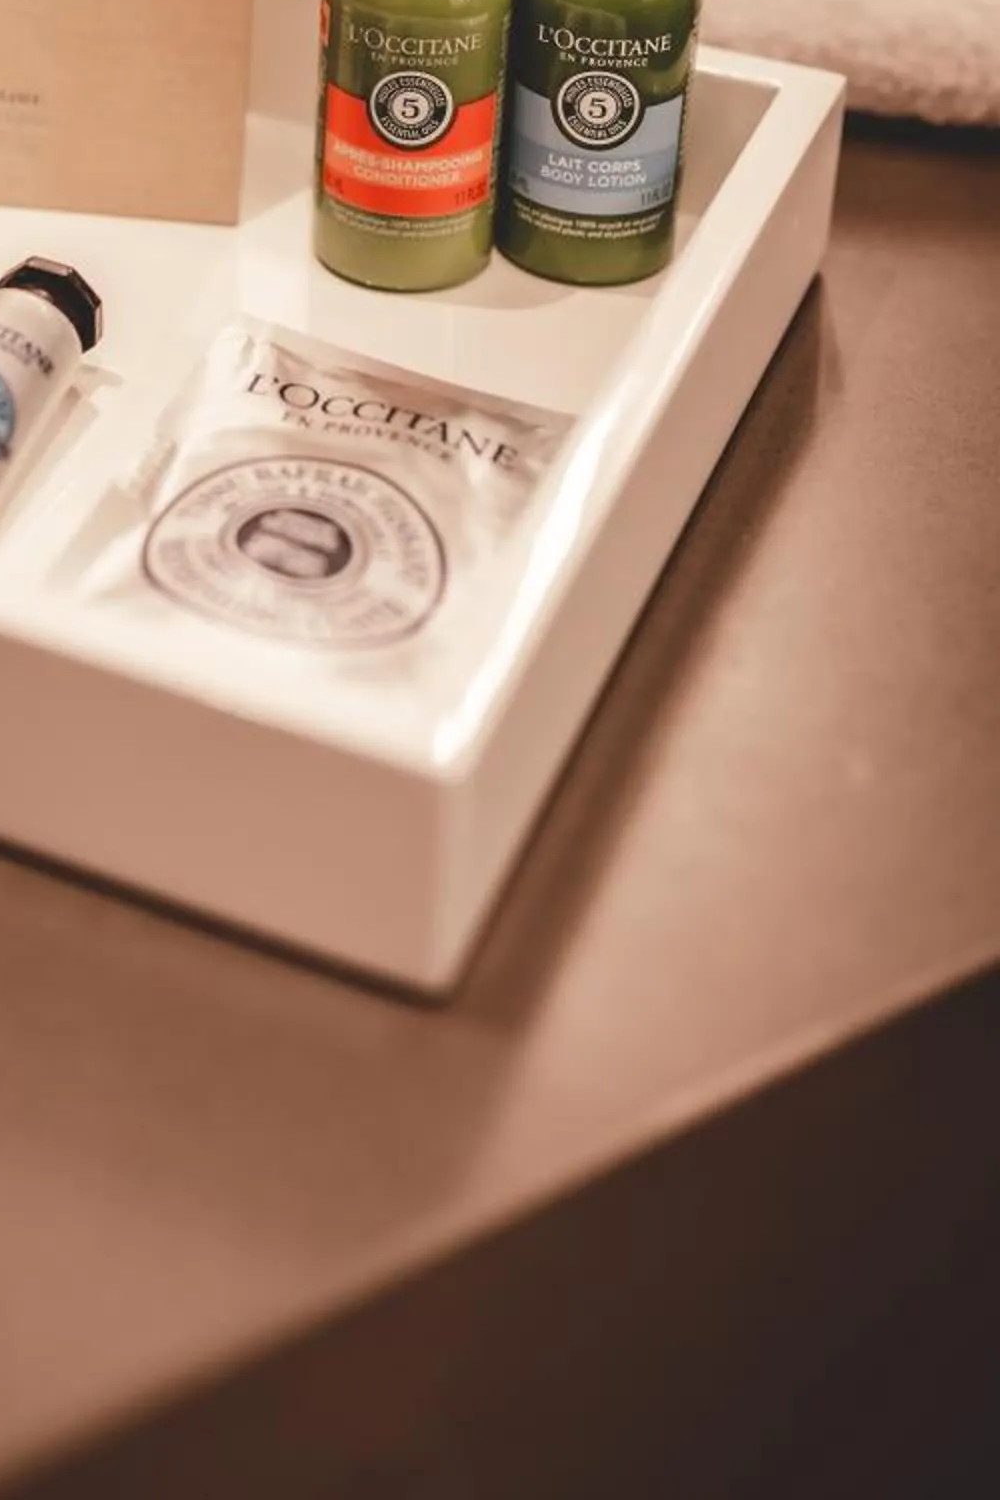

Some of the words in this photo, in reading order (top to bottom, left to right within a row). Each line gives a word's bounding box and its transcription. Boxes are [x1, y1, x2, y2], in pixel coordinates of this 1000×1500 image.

[349, 24, 482, 56] L'OCCITANE
[537, 23, 672, 57] L'OCCITANE
[560, 51, 576, 62] EN
[581, 55, 649, 68] PROVENCE
[401, 97, 420, 119] 5
[588, 97, 607, 119] 5
[548, 153, 584, 171] LAIT
[587, 159, 642, 174] CORPS
[540, 164, 584, 185] BODY
[587, 172, 647, 188] LOTION
[247, 373, 519, 471] L'OCCITANE
[282, 410, 312, 429] EN
[322, 419, 452, 462] PROVENCE
